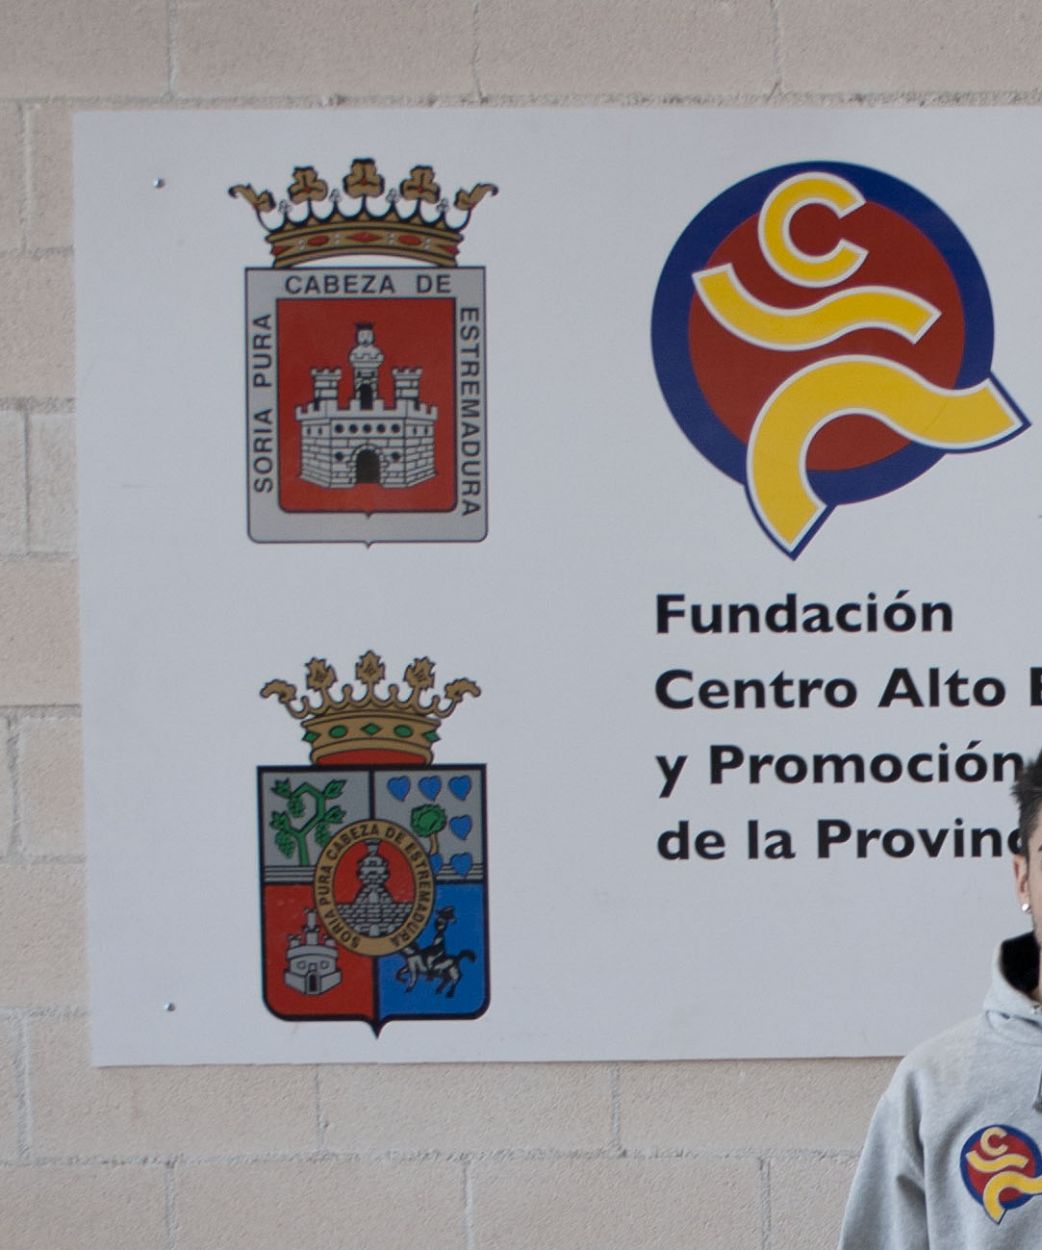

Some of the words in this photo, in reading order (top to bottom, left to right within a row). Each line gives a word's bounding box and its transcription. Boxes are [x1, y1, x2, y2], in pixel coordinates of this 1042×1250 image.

[284, 274, 396, 295] CABEZA
[415, 274, 452, 294] DE
[252, 314, 273, 388] PURA
[459, 306, 482, 517] ESTREMADURA
[253, 408, 274, 493] SORIA
[656, 590, 953, 634] Fundación
[655, 668, 858, 710] Centro
[878, 667, 1006, 708] Alto
[656, 755, 688, 798] y
[709, 740, 1024, 785] Promoción
[657, 820, 726, 860] de
[748, 819, 796, 860] la
[318, 865, 334, 906] PURA
[324, 909, 360, 949] SORIA
